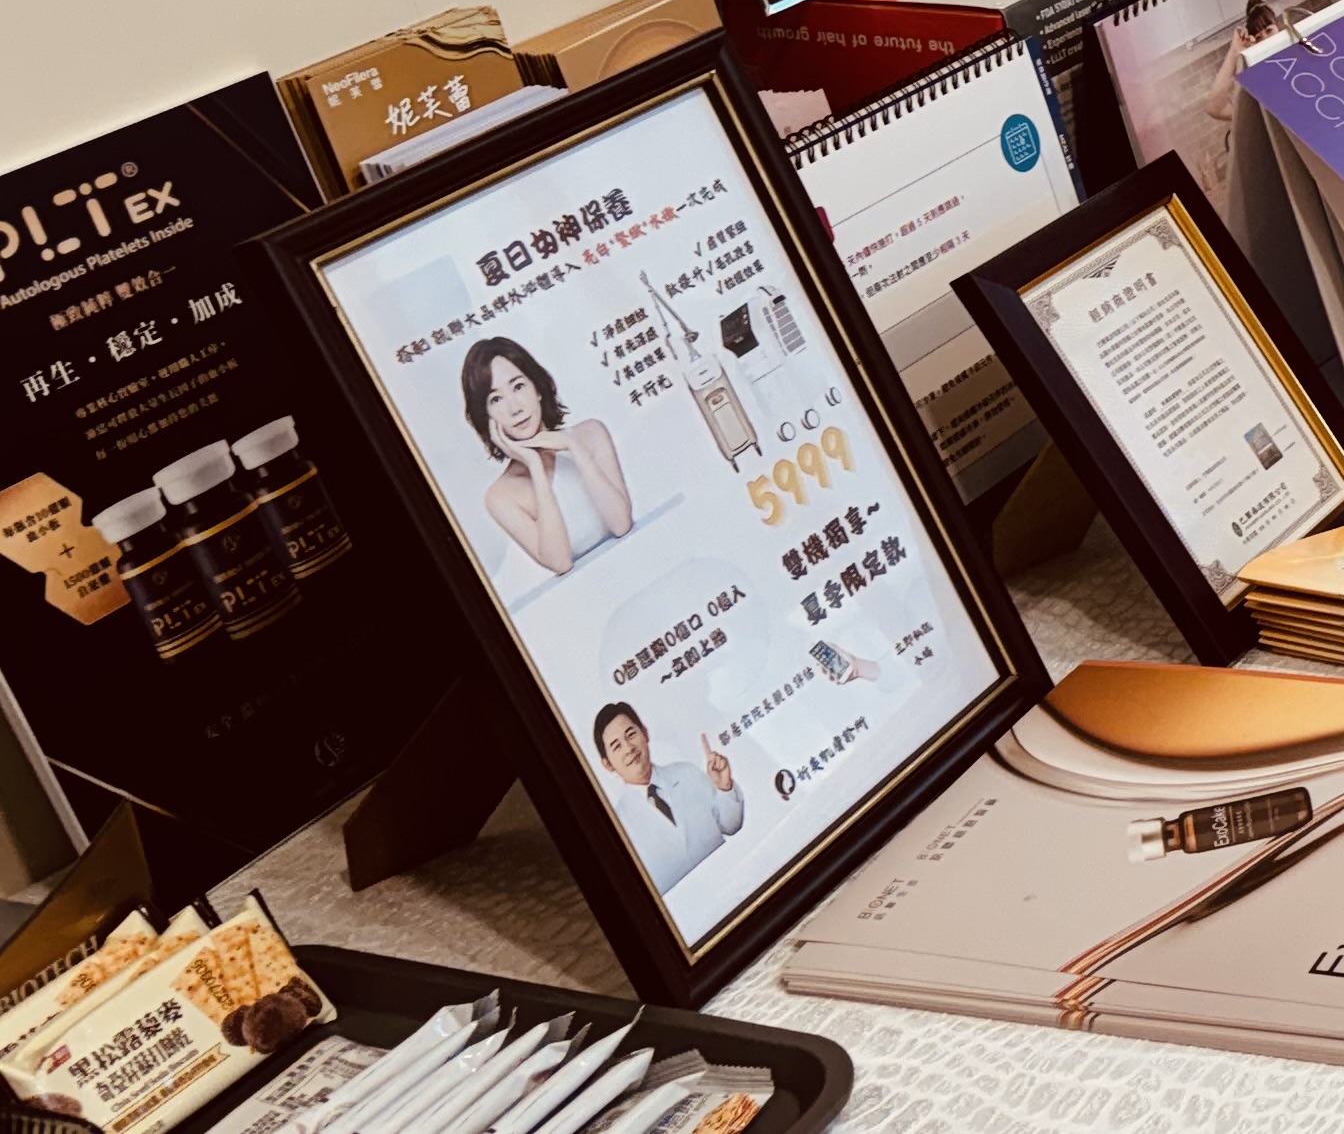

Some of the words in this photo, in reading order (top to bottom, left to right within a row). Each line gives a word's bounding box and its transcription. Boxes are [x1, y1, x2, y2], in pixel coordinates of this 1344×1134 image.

[815, 30, 845, 47] hair
[852, 33, 867, 48] of
[872, 34, 922, 52] future
[0, 263, 87, 310] Autologous
[86, 235, 150, 270] Platelets
[150, 217, 194, 244] Inside
[474, 187, 635, 288] 夏日女神保養
[747, 425, 857, 526] 5999
[800, 535, 907, 626] 夏季限定款
[1212, 807, 1229, 847] ExoCake
[69, 997, 184, 1090] 黑松露藜麥
